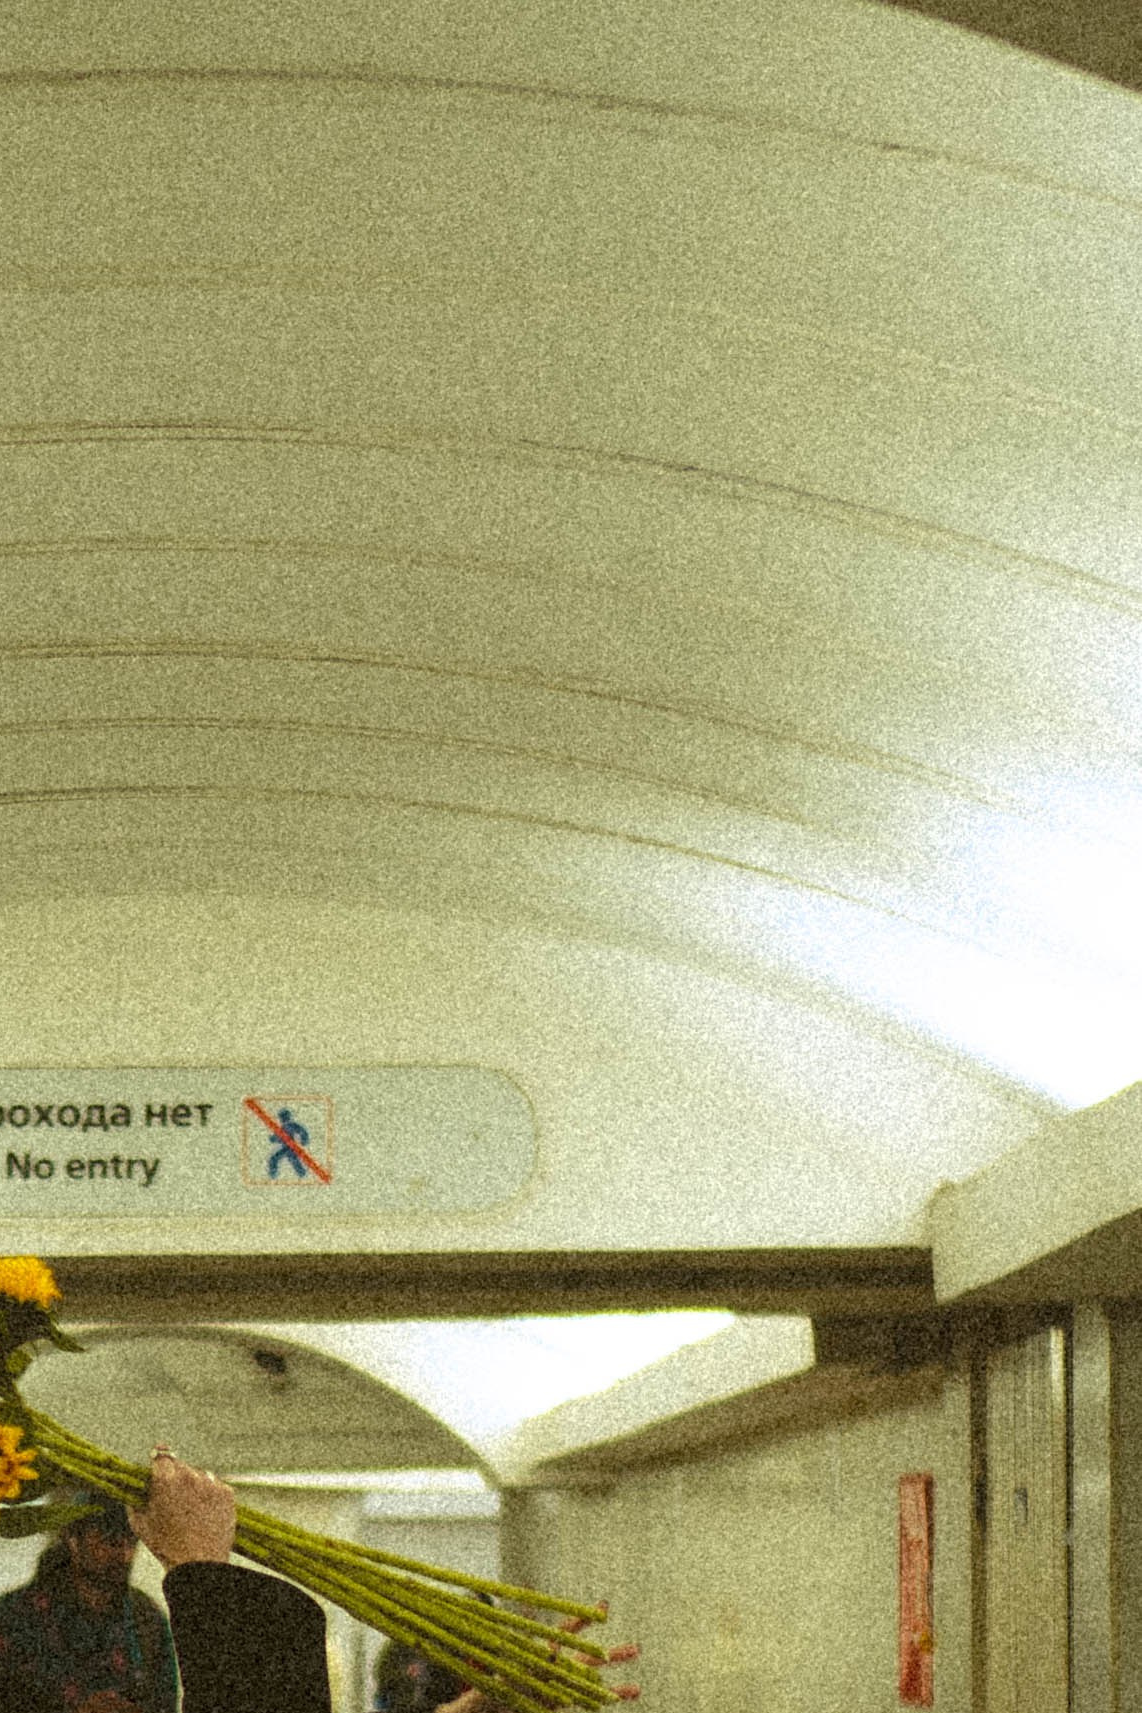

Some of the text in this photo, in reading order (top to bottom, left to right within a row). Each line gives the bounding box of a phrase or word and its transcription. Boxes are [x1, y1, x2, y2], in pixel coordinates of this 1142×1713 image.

[144, 1102, 213, 1127] нет
[5, 1151, 160, 1188] No entry
